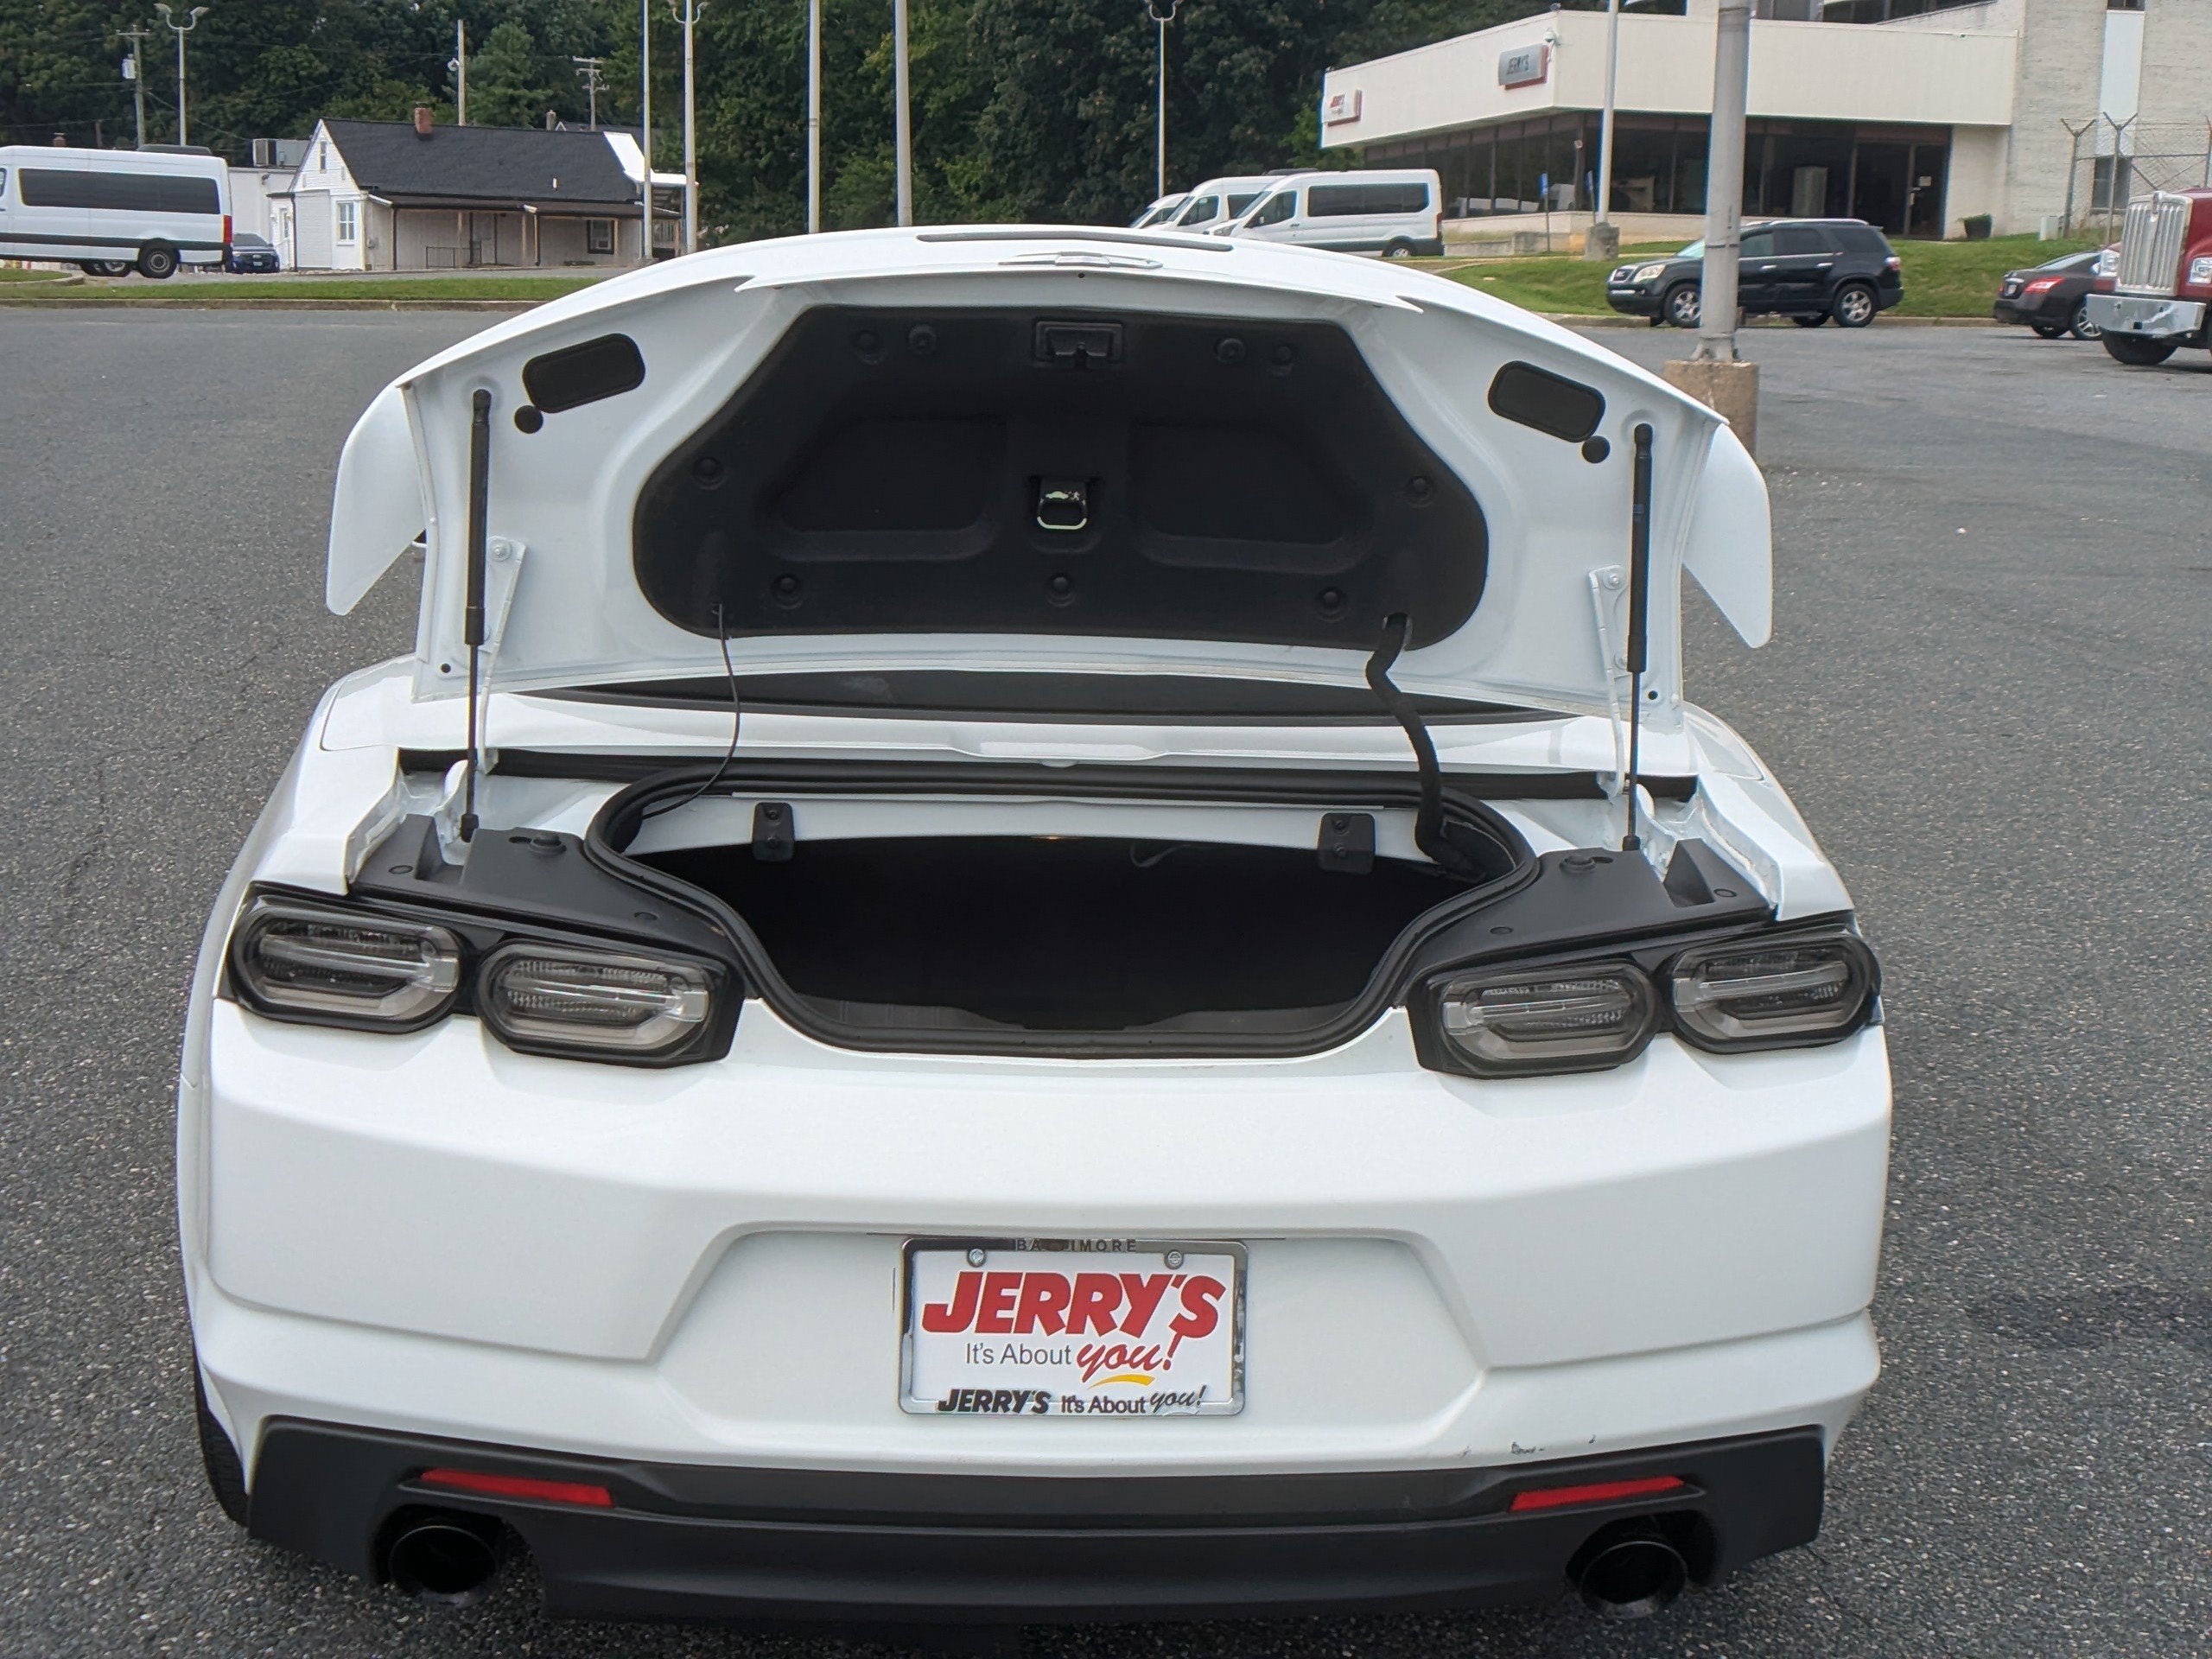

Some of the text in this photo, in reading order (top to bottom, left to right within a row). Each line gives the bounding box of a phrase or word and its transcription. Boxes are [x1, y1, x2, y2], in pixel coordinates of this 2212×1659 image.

[1016, 1238, 1137, 1252] BAIMORE
[921, 1271, 1227, 1338] JERRY'S
[966, 1332, 1181, 1383] It's About you!
[937, 1384, 1206, 1414] JERRY'S It's About you!
